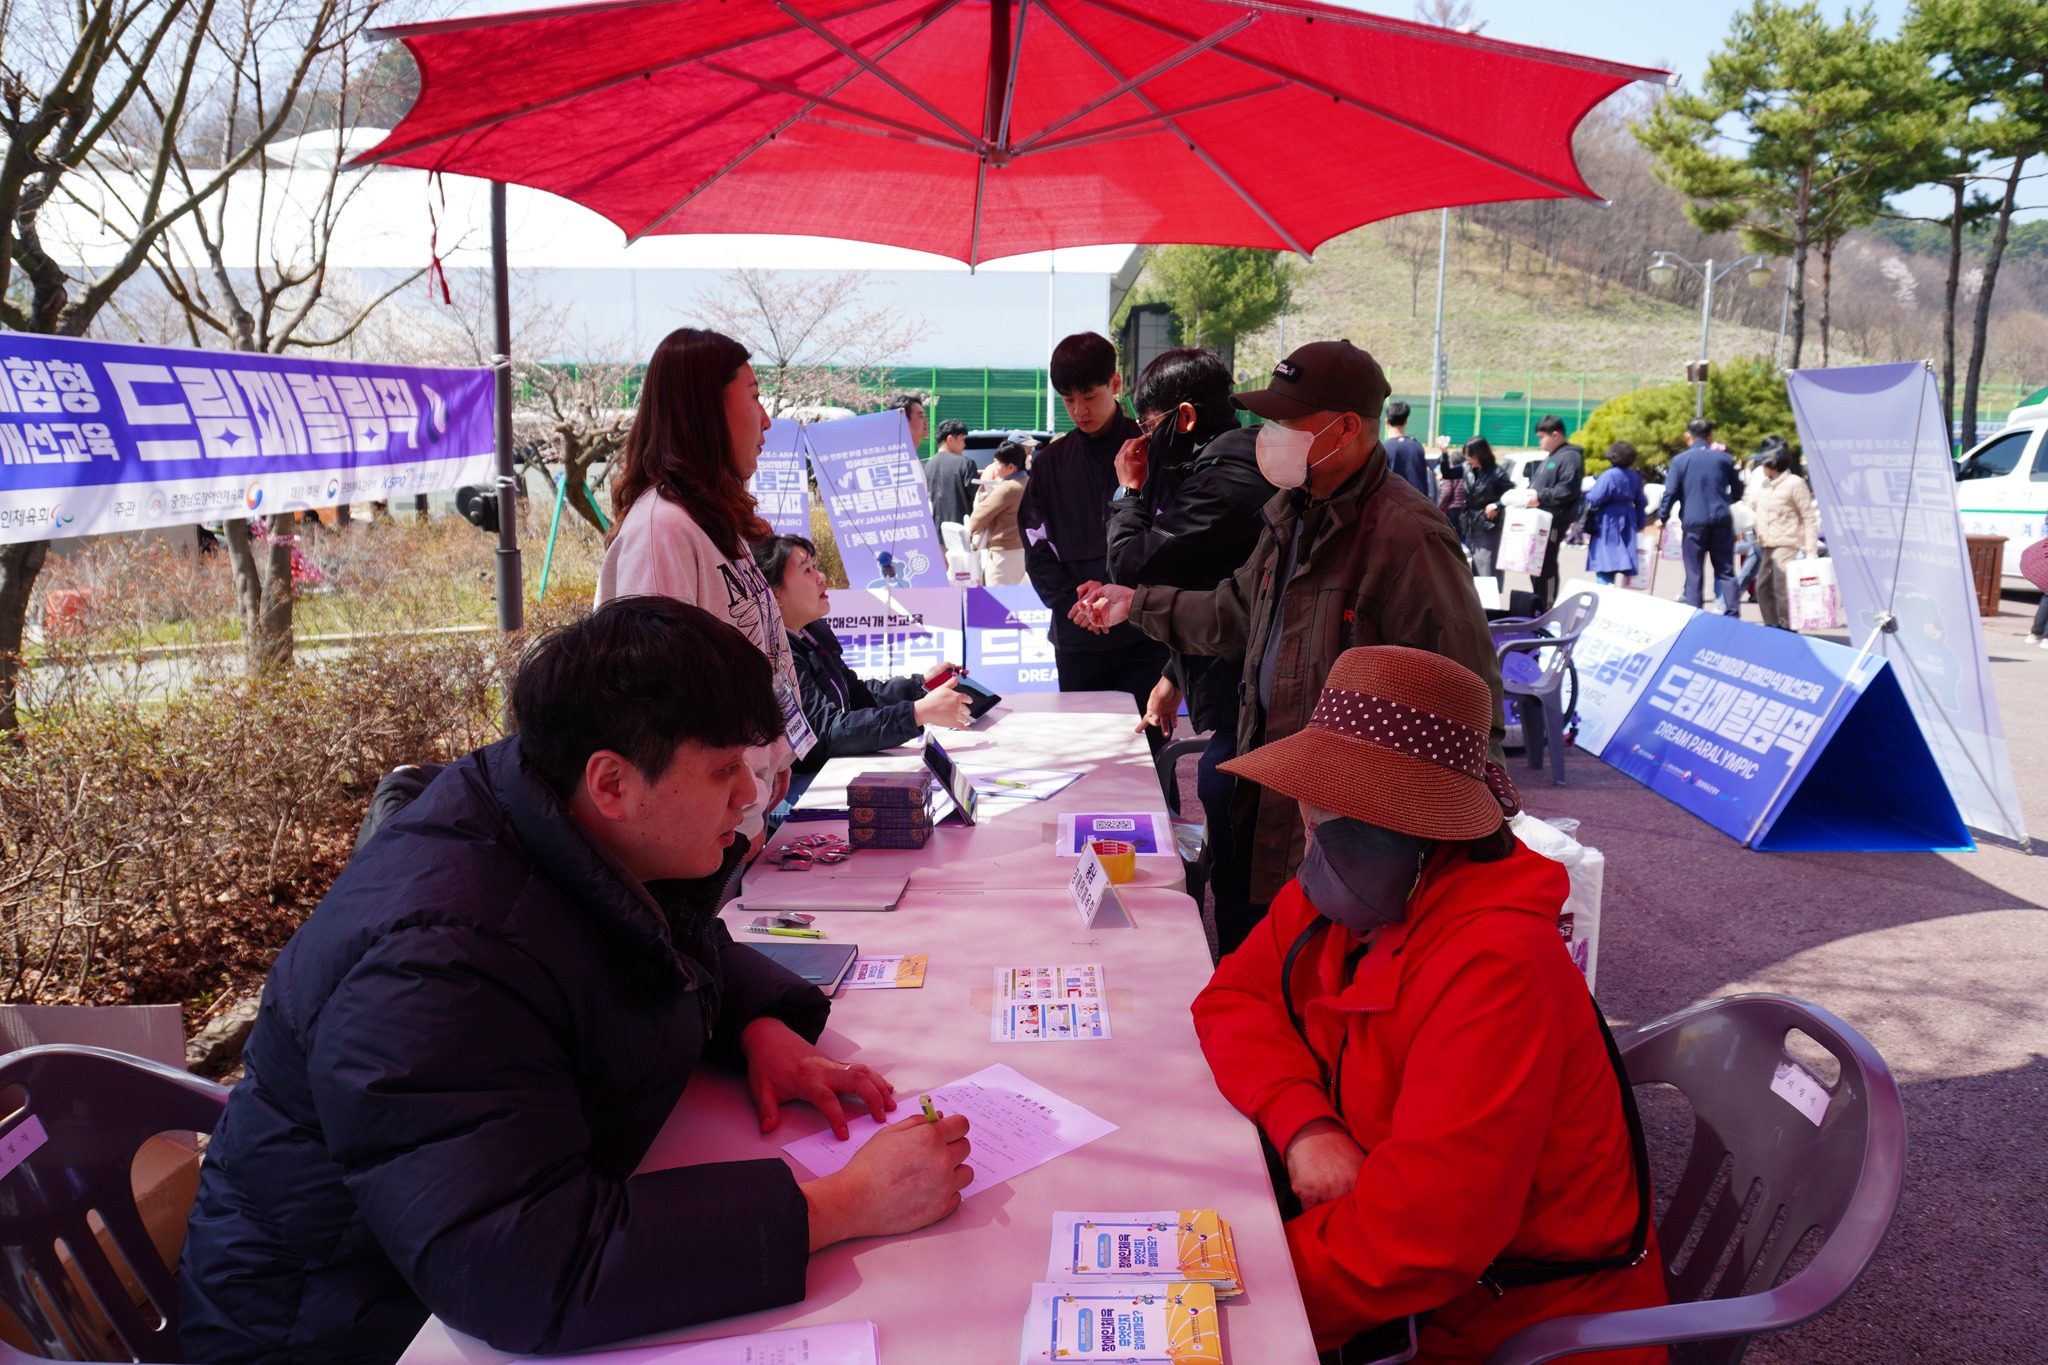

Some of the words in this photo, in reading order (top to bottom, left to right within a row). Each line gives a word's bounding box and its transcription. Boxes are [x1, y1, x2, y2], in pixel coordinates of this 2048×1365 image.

[102, 361, 419, 463] 드림패럴림픽
[382, 476, 406, 489] KSPO
[114, 501, 136, 517] 주관
[1005, 609, 1053, 624] 스포츠
[836, 631, 944, 668] 럴림픽
[981, 627, 1056, 666] 드림
[1577, 634, 1654, 694] 럴림픽
[1018, 667, 1059, 682] DREA
[1690, 648, 1748, 678] 스포츠체험형
[1741, 662, 1825, 704] 장애인식개선교육
[1648, 663, 1824, 768] 드림패럴림픽
[1654, 719, 1694, 750] DREAM
[1686, 732, 1761, 780] PARALYMPIC
[1118, 1233, 1132, 1269] 장애인체육
[1133, 1239, 1146, 1265] 무엇인지
[1147, 1235, 1159, 1268] 알아볼까요?
[1100, 1308, 1116, 1352] 장애인체육
[1117, 1314, 1132, 1347] 무엇인지
[1132, 1310, 1146, 1351] 알아볼까요?
